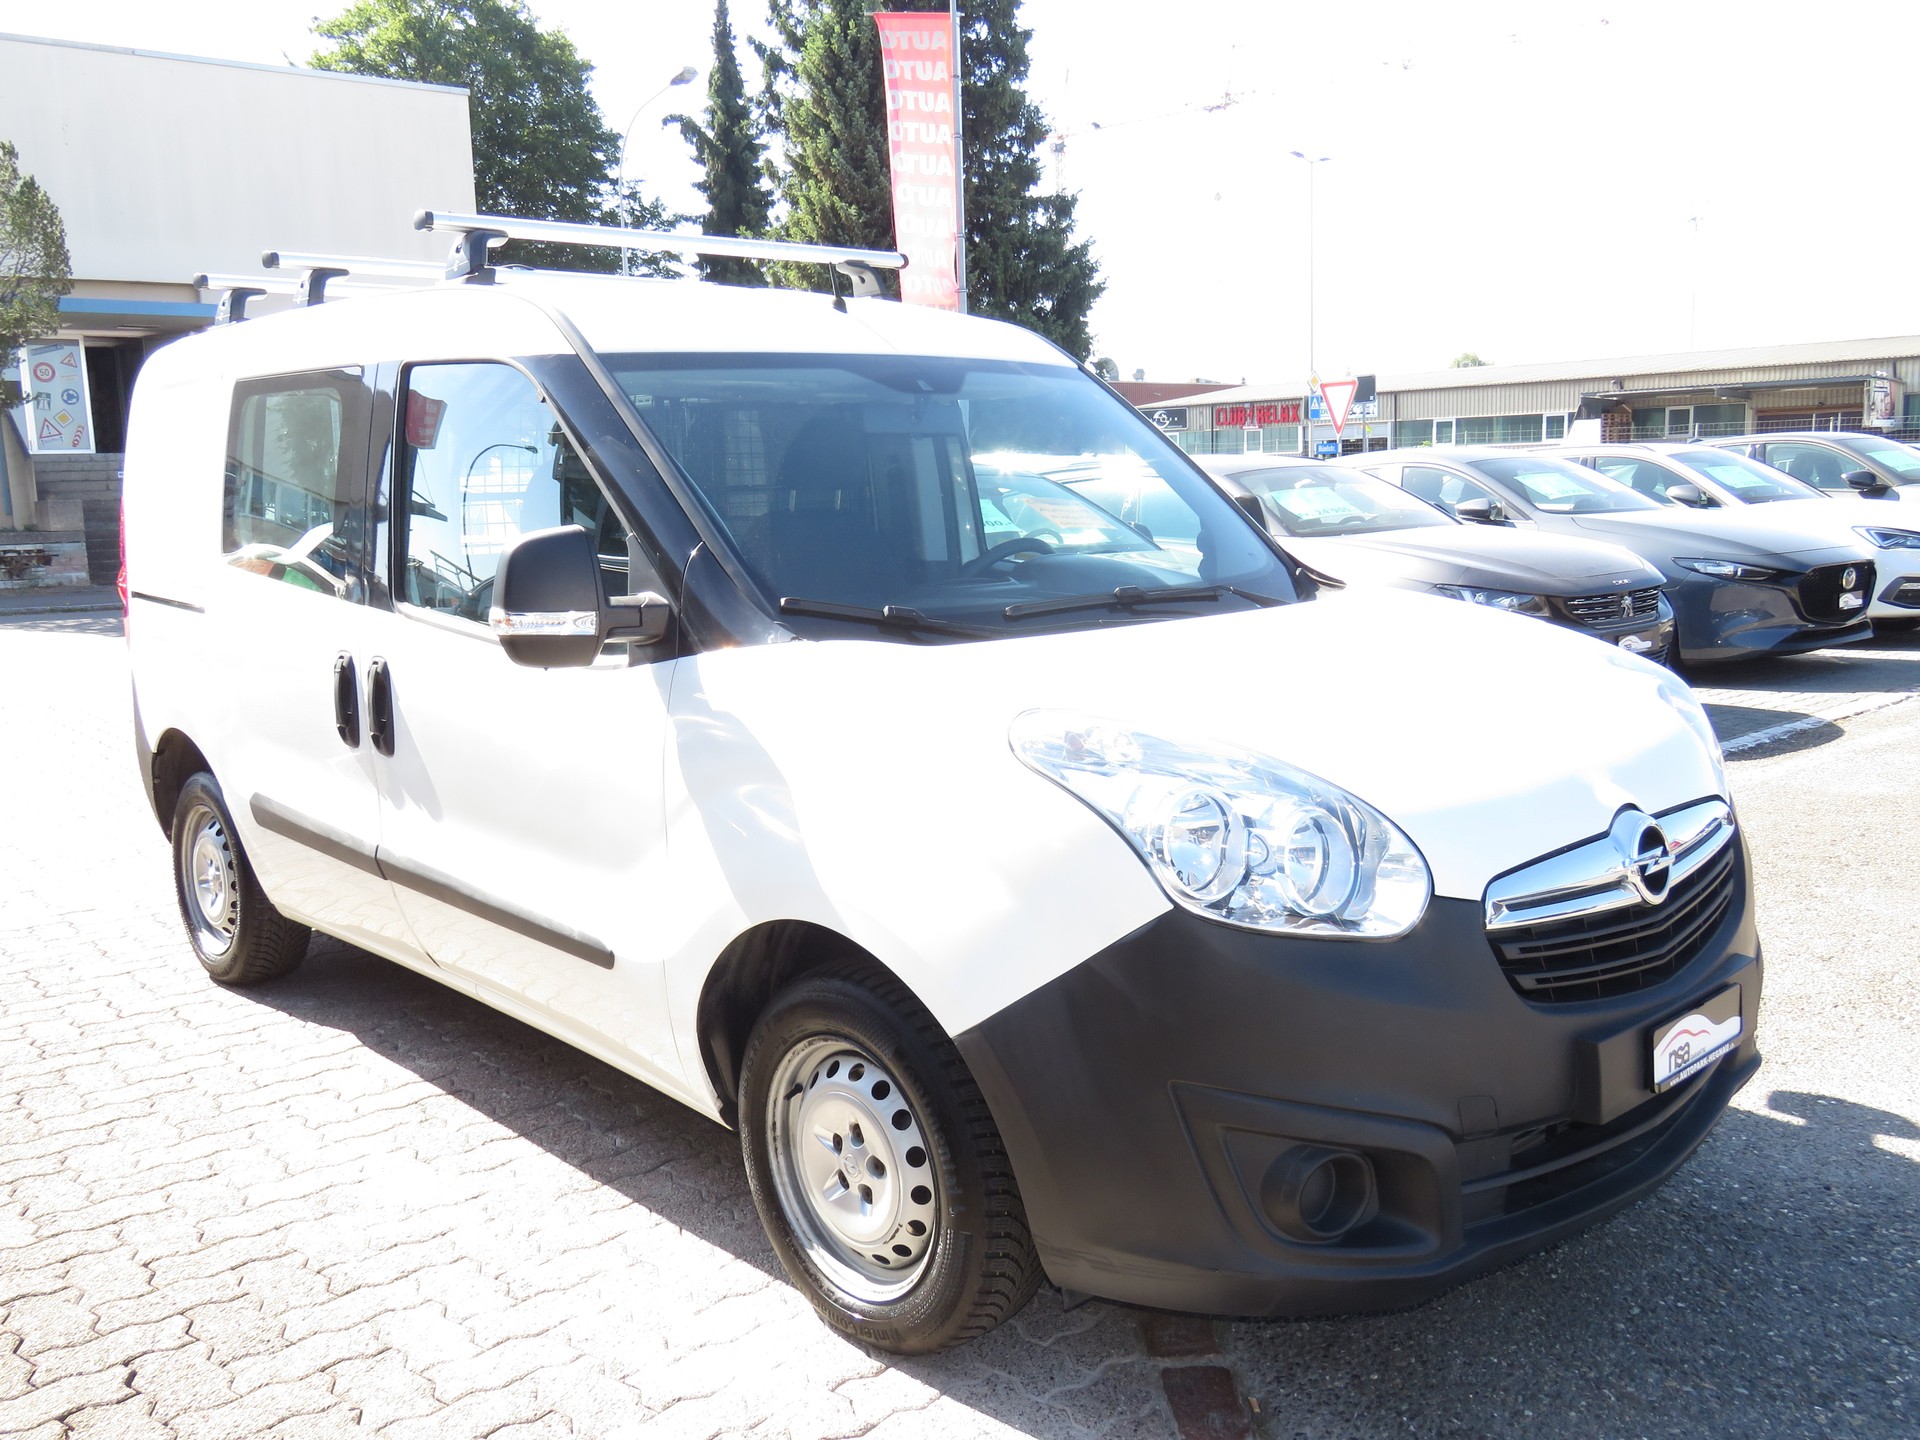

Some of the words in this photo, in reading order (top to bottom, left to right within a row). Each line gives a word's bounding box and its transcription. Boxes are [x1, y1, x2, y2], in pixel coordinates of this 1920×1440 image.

[39, 368, 50, 377] 50
[1215, 406, 1246, 427] CLUB
[1256, 403, 1300, 425] RELAX
